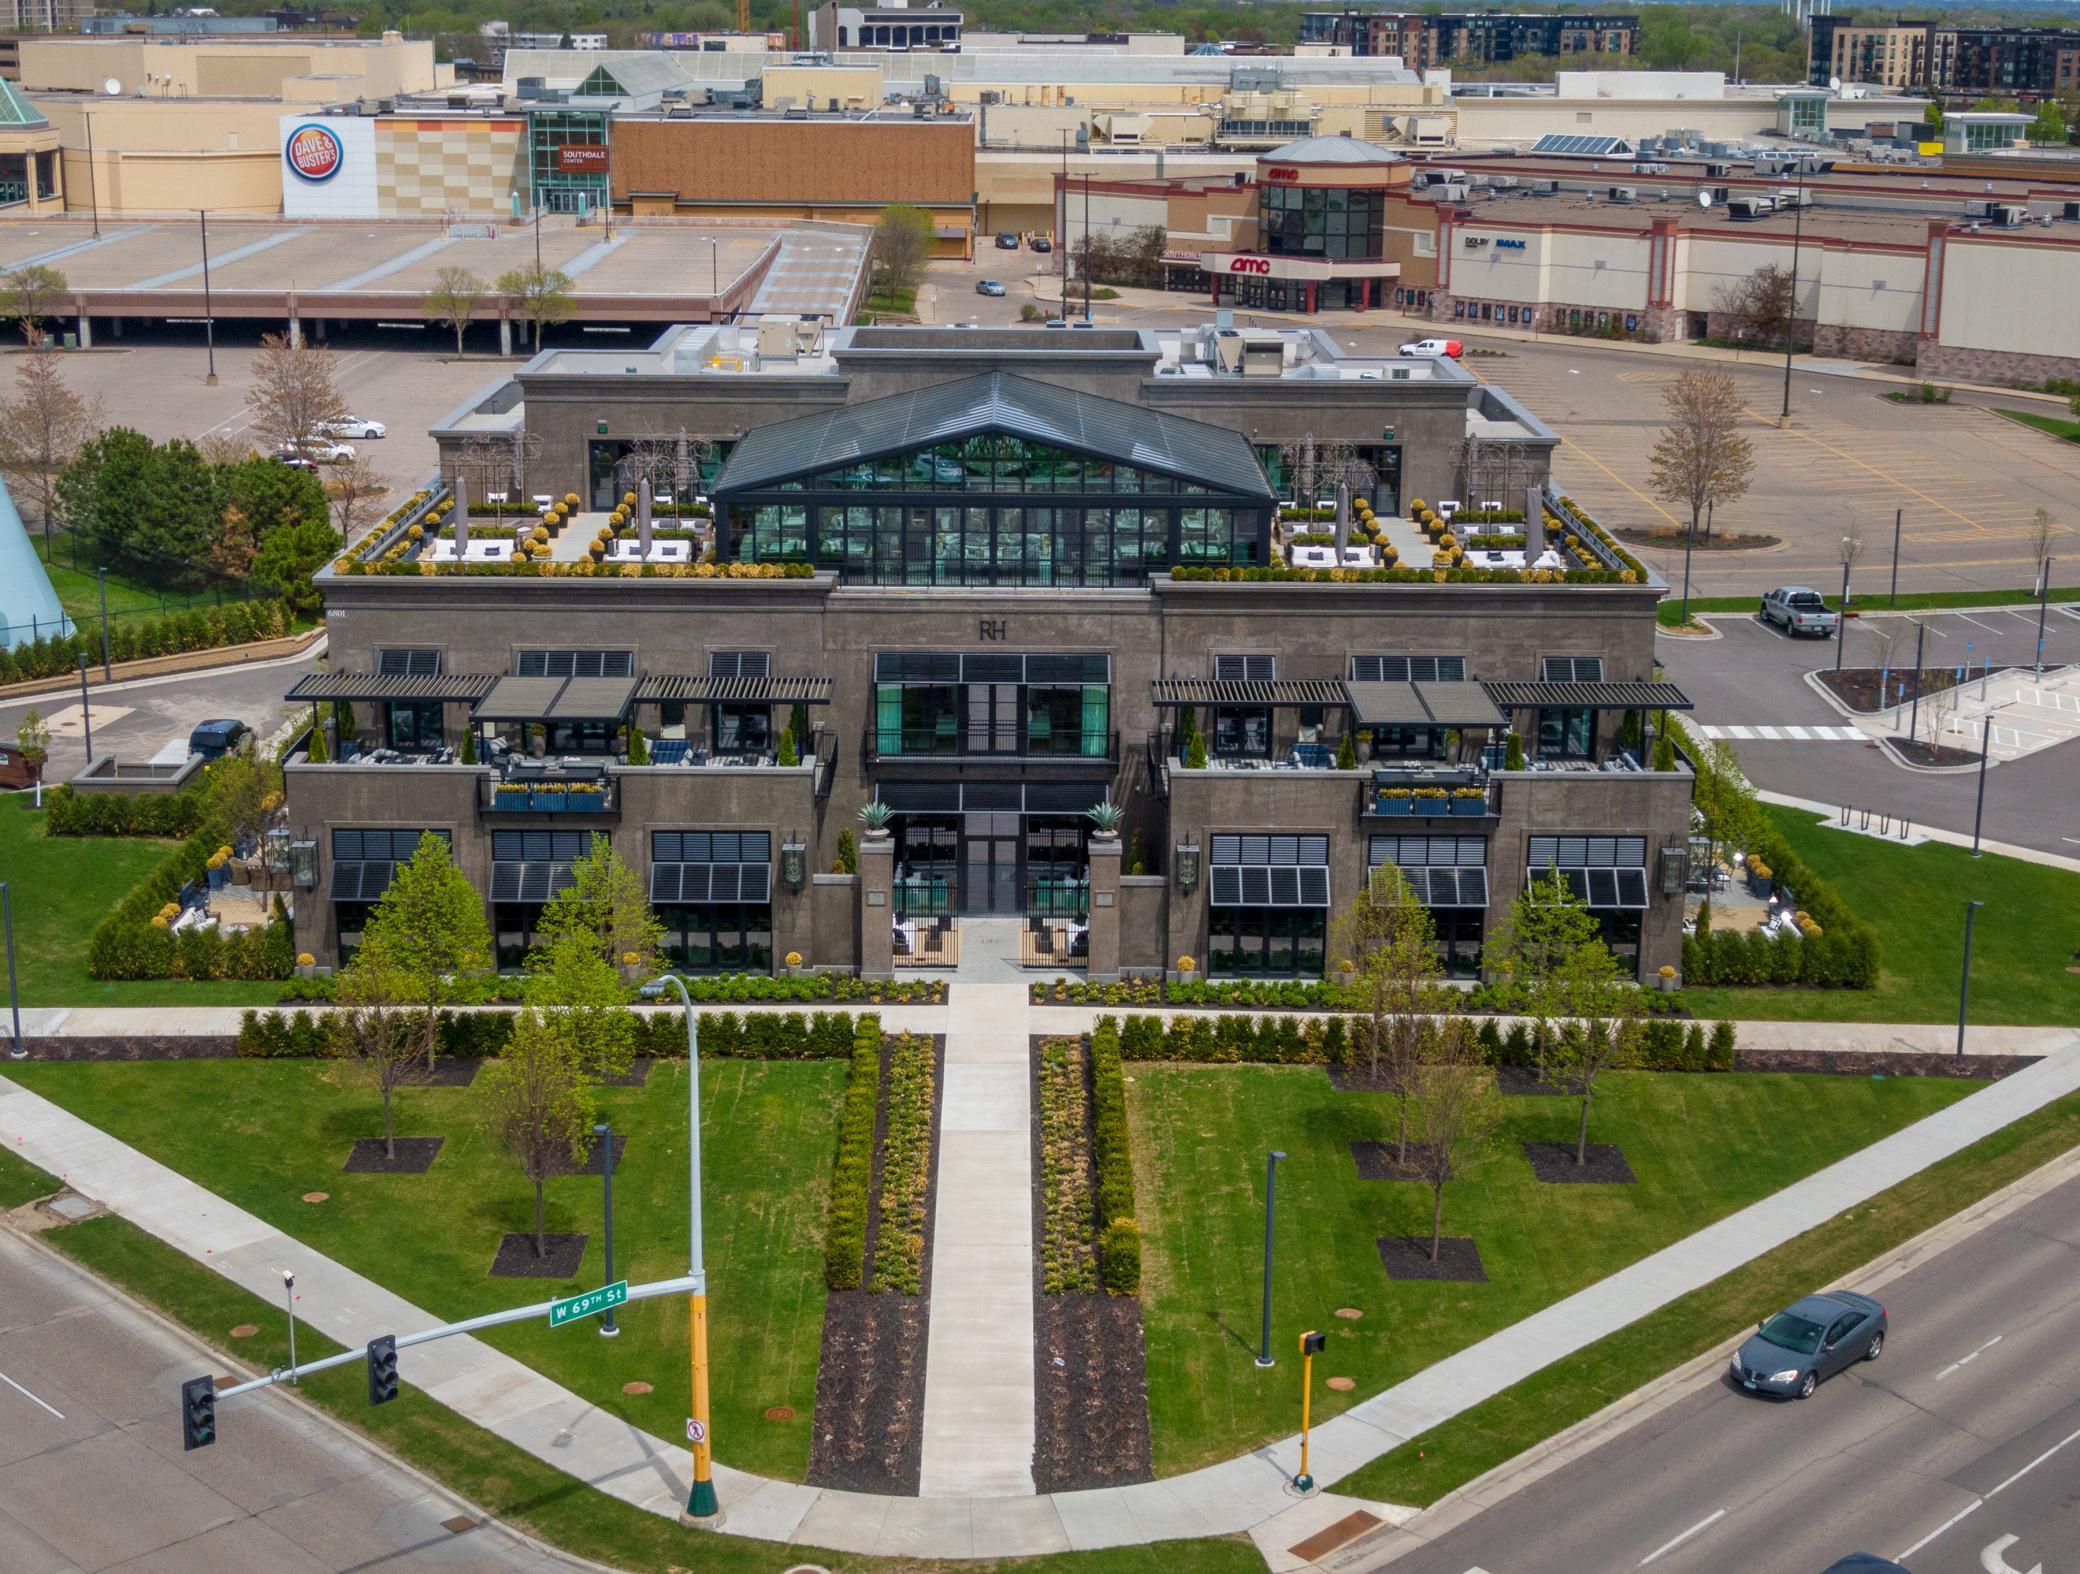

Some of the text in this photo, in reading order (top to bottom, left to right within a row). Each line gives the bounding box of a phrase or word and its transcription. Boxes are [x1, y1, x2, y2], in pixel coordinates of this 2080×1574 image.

[295, 136, 334, 157] DAVE &
[563, 151, 606, 159] SOUTHDALE
[1465, 237, 1526, 249] DOLBY IMAX
[327, 609, 346, 618] 6801
[979, 620, 1007, 641] RH
[556, 1288, 622, 1319] W 69TH St
